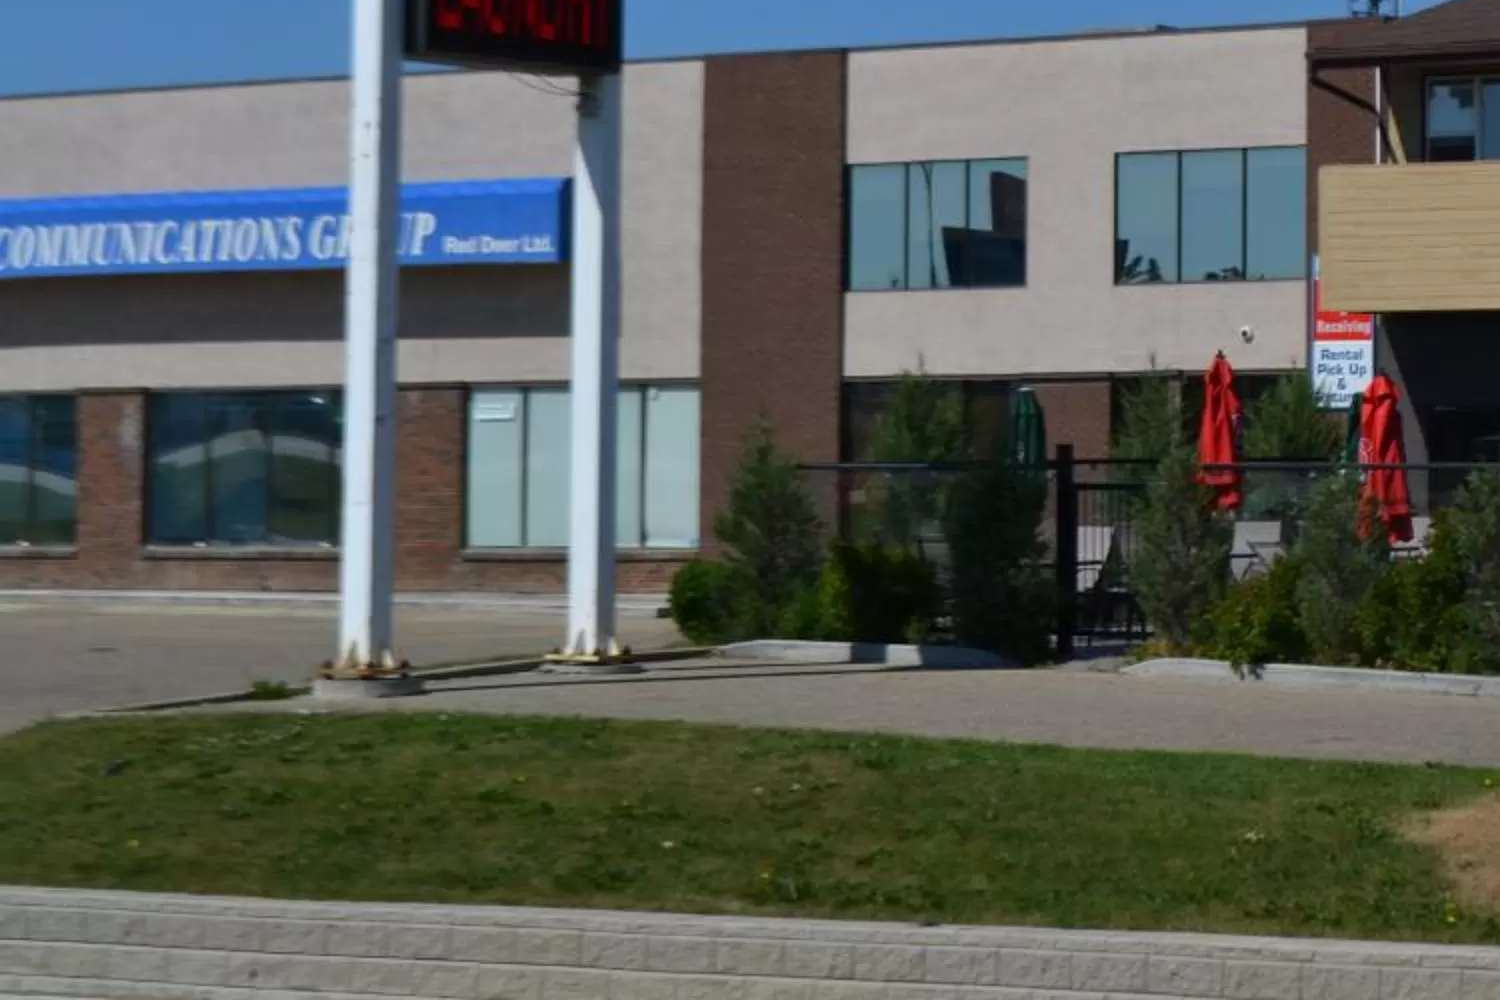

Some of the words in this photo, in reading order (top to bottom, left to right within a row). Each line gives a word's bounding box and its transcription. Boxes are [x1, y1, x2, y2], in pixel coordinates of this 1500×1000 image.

[308, 211, 437, 261] GRP
[1320, 348, 1364, 361] Rental
[1317, 363, 1344, 375] Pick
[1348, 363, 1367, 378] Up
